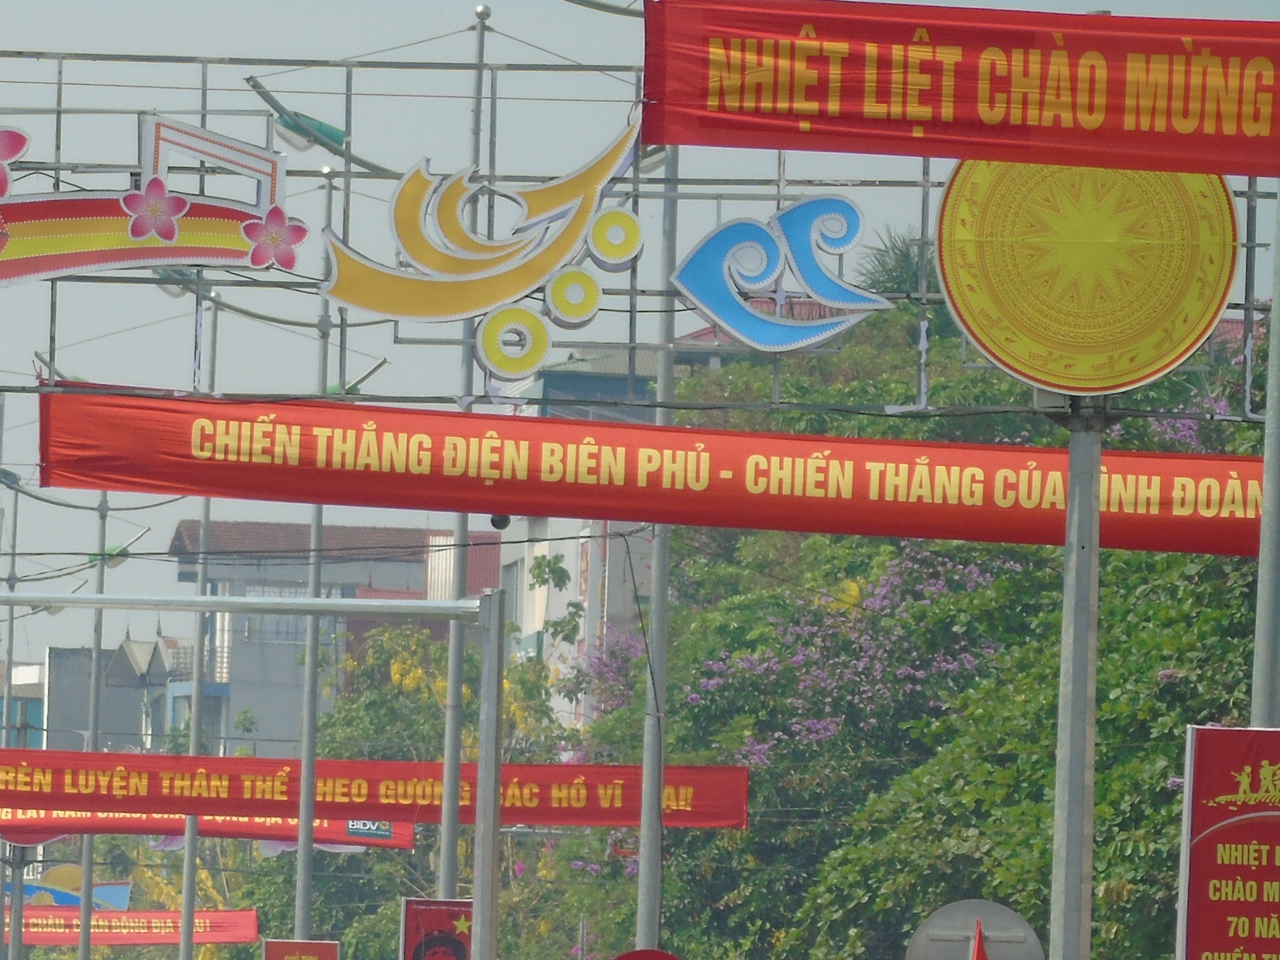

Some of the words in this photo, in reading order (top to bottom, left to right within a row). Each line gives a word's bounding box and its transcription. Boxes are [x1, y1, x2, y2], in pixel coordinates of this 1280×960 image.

[706, 23, 849, 132] NHIỆT
[862, 27, 963, 138] LIỆT
[977, 32, 1108, 130] CHÀO
[1123, 37, 1276, 138] MỪNG
[190, 413, 302, 465] CHIẾN
[312, 420, 431, 475] THẮNG
[442, 431, 529, 486] ĐIỆN
[541, 437, 626, 486] BIÊN
[636, 443, 710, 491] PHỦ
[745, 450, 854, 500] CHIẾN
[866, 456, 986, 506] THẮNG
[994, 461, 1066, 510] CỦA
[1099, 465, 1161, 516] ÌNH
[64, 765, 149, 799] LUYỆN
[160, 768, 229, 799] THÂN
[241, 766, 291, 801] THỂ
[315, 777, 369, 804] HEO
[498, 777, 540, 808] ÁC
[552, 776, 588, 808] HỒ
[598, 779, 625, 809] VĨ
[1216, 840, 1269, 870] NHIỆT
[1208, 876, 1257, 902] CHÀO
[1227, 915, 1249, 938] 70
